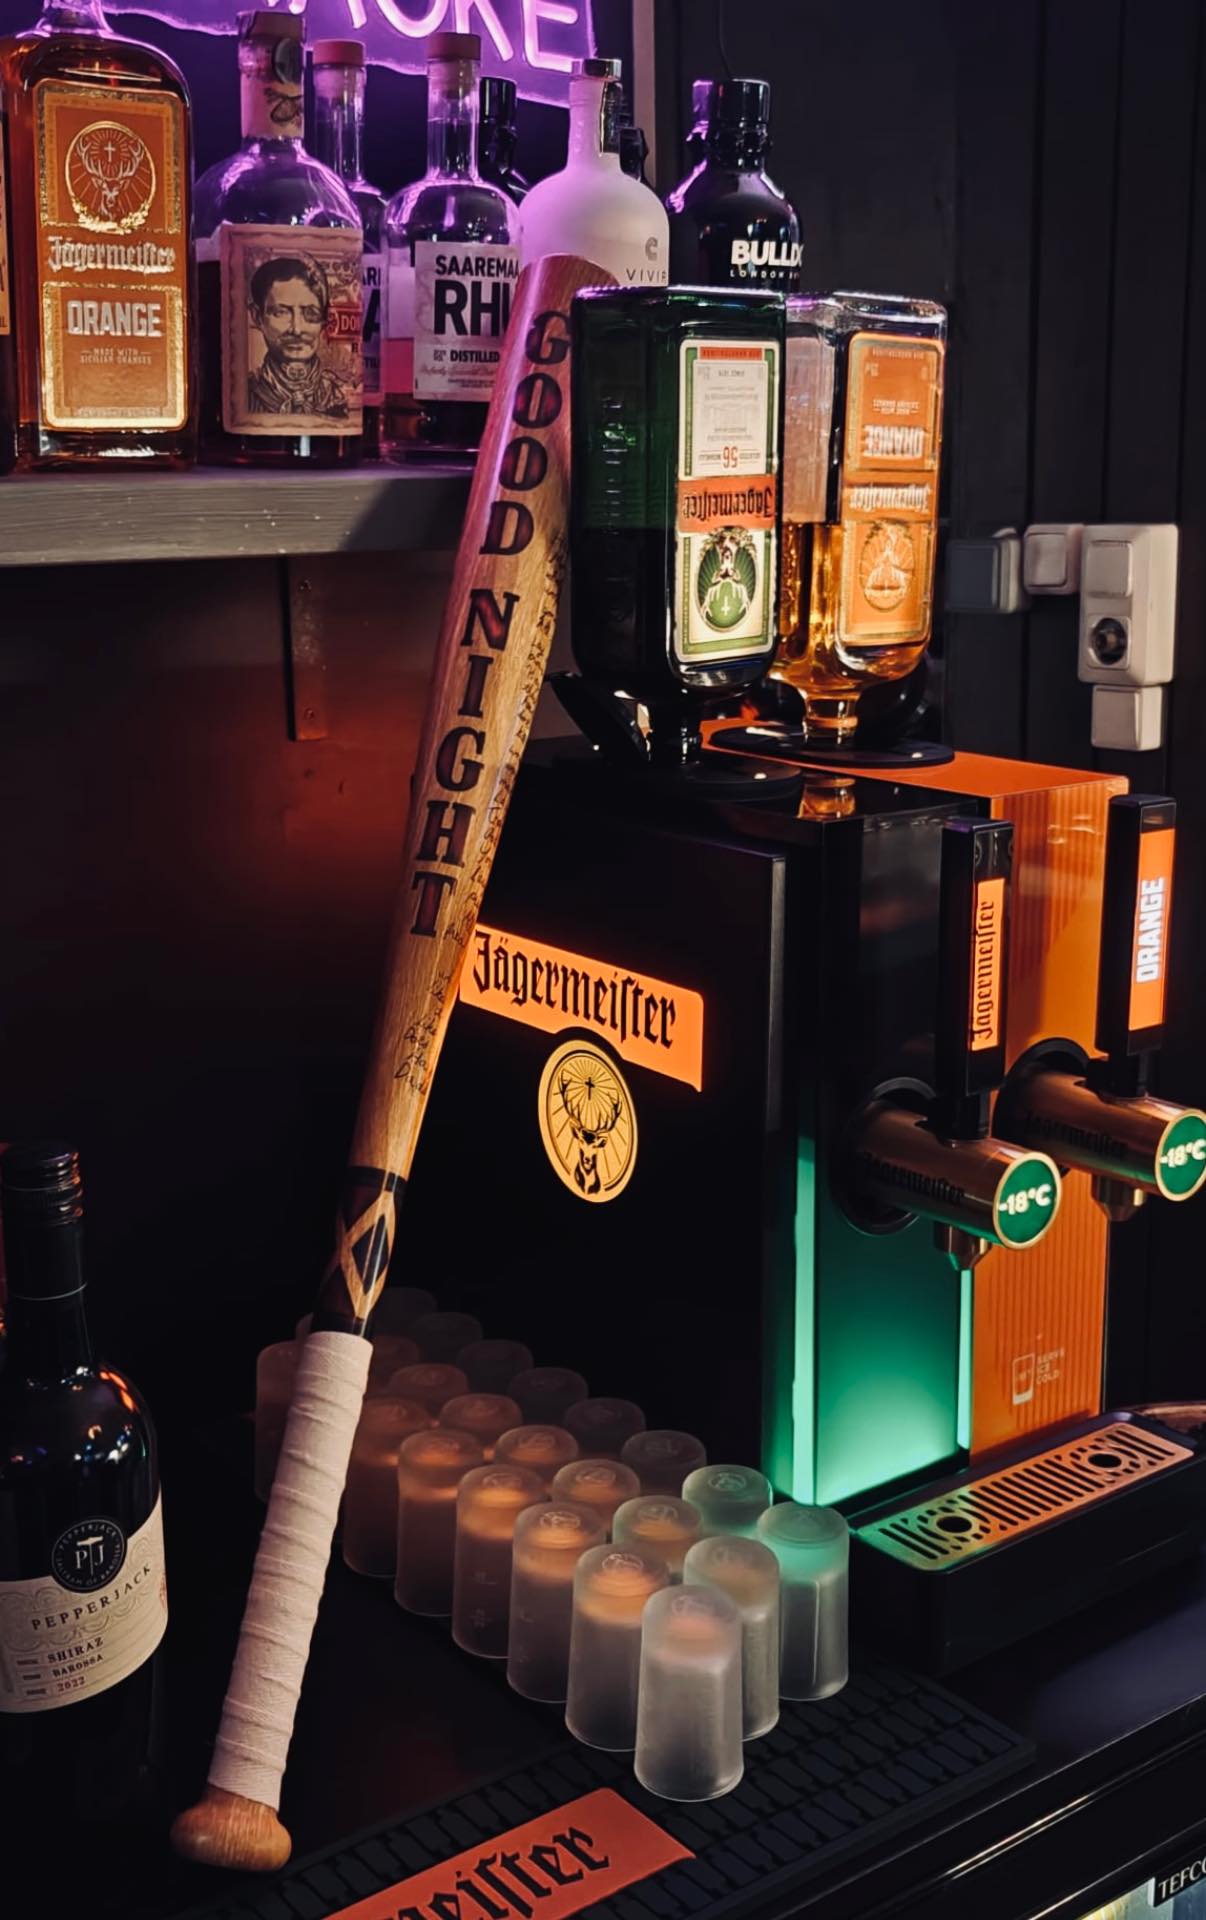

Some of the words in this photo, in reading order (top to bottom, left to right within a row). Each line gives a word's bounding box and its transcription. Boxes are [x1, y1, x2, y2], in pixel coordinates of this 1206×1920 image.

[67, 300, 163, 338] ORANGE
[480, 311, 572, 554] GOOD
[723, 446, 739, 469] 56
[409, 588, 520, 938] NIGHT
[1135, 876, 1165, 984] ORANGE
[998, 1183, 1051, 1215] -18°C
[32, 1565, 151, 1631] PEPPERJACK
[47, 1636, 104, 1664] SHIRAZ
[52, 1654, 104, 1678] BAROSSA
[57, 1675, 86, 1692] 2022
